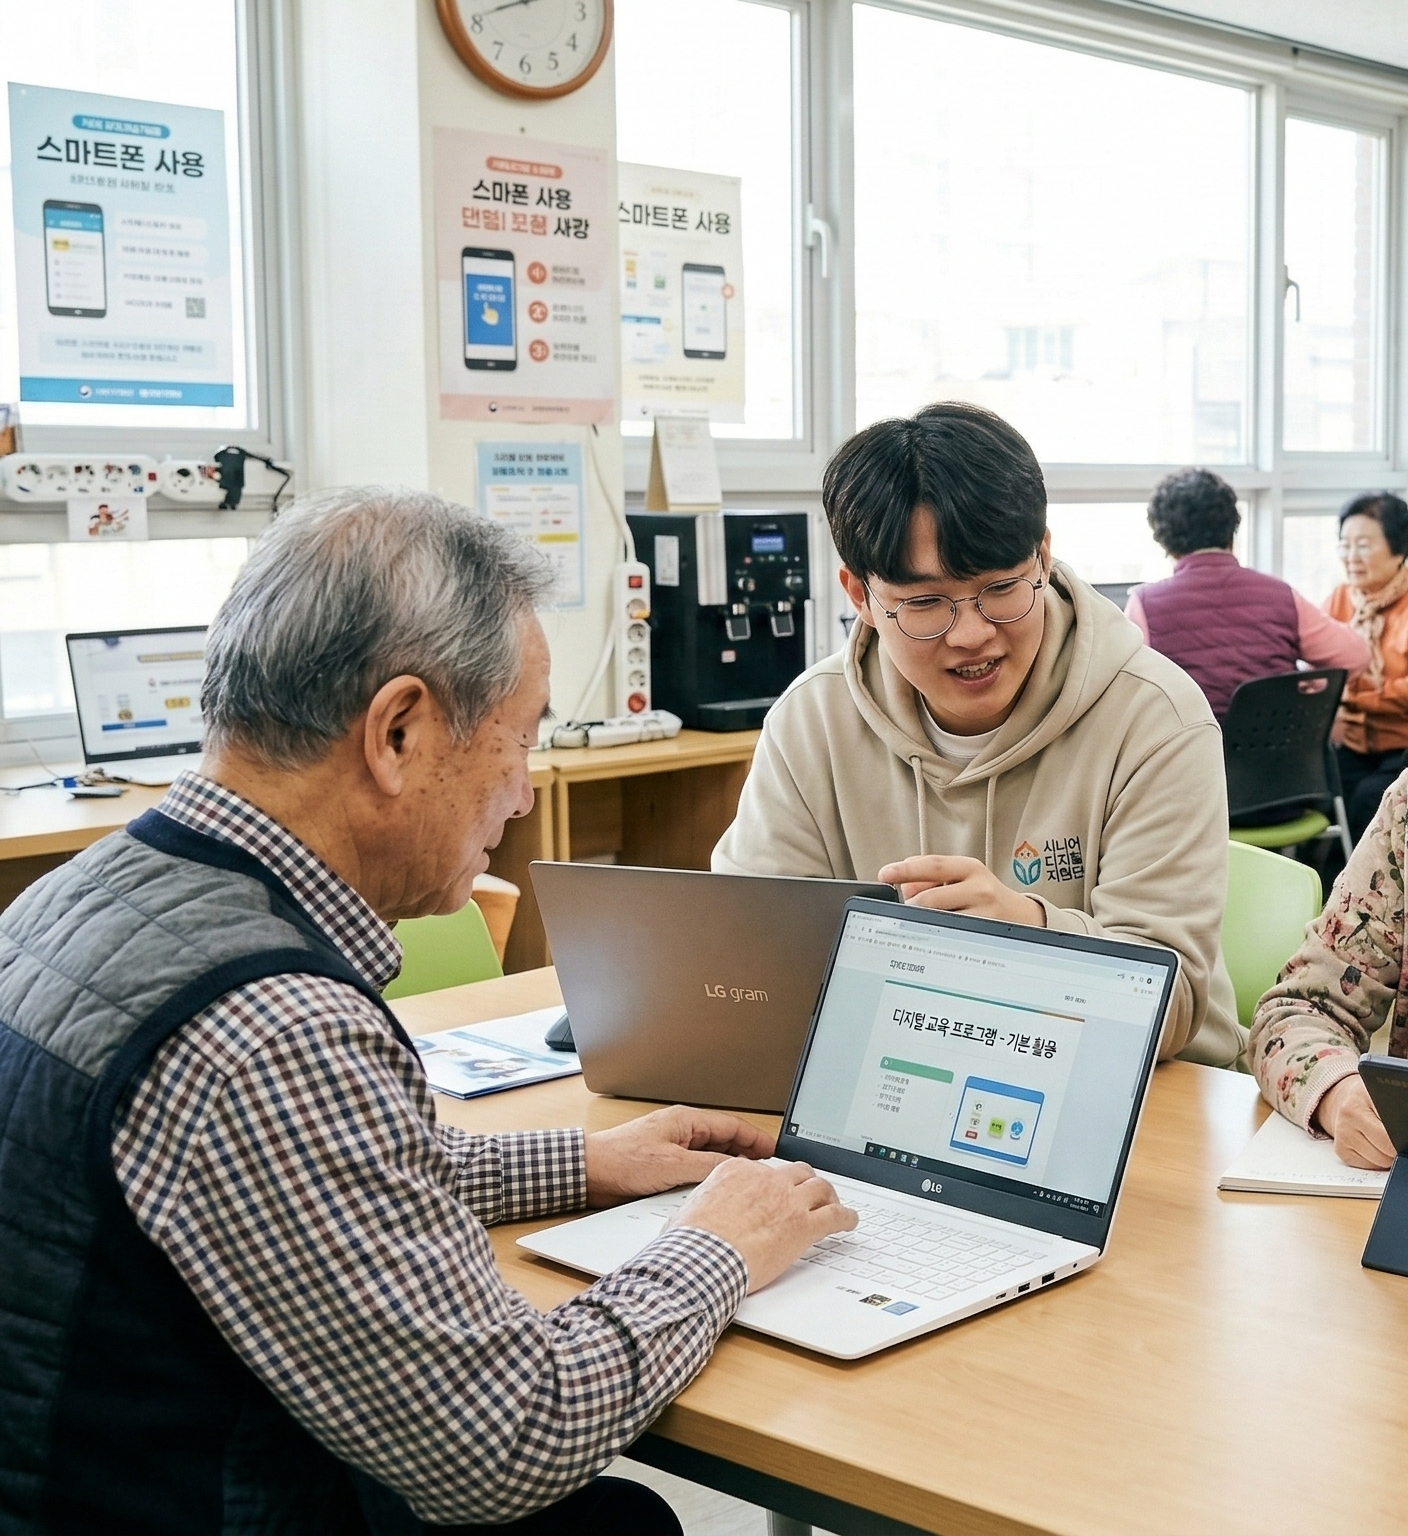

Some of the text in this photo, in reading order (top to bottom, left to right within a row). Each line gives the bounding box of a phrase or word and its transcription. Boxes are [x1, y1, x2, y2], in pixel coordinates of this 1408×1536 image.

[493, 40, 504, 60] 7
[567, 33, 577, 51] 4
[519, 56, 531, 74] 6
[549, 51, 559, 70] 5
[36, 135, 204, 178] 스마트폰 사용
[473, 180, 571, 210] 스마폰 사용
[619, 202, 730, 234] 스마트폰 사용
[1044, 836, 1081, 852] 시니어
[704, 984, 769, 1003] LG gram
[893, 1009, 926, 1031] 디지털
[925, 1016, 950, 1037] 교육
[950, 1022, 997, 1046] 프로그램
